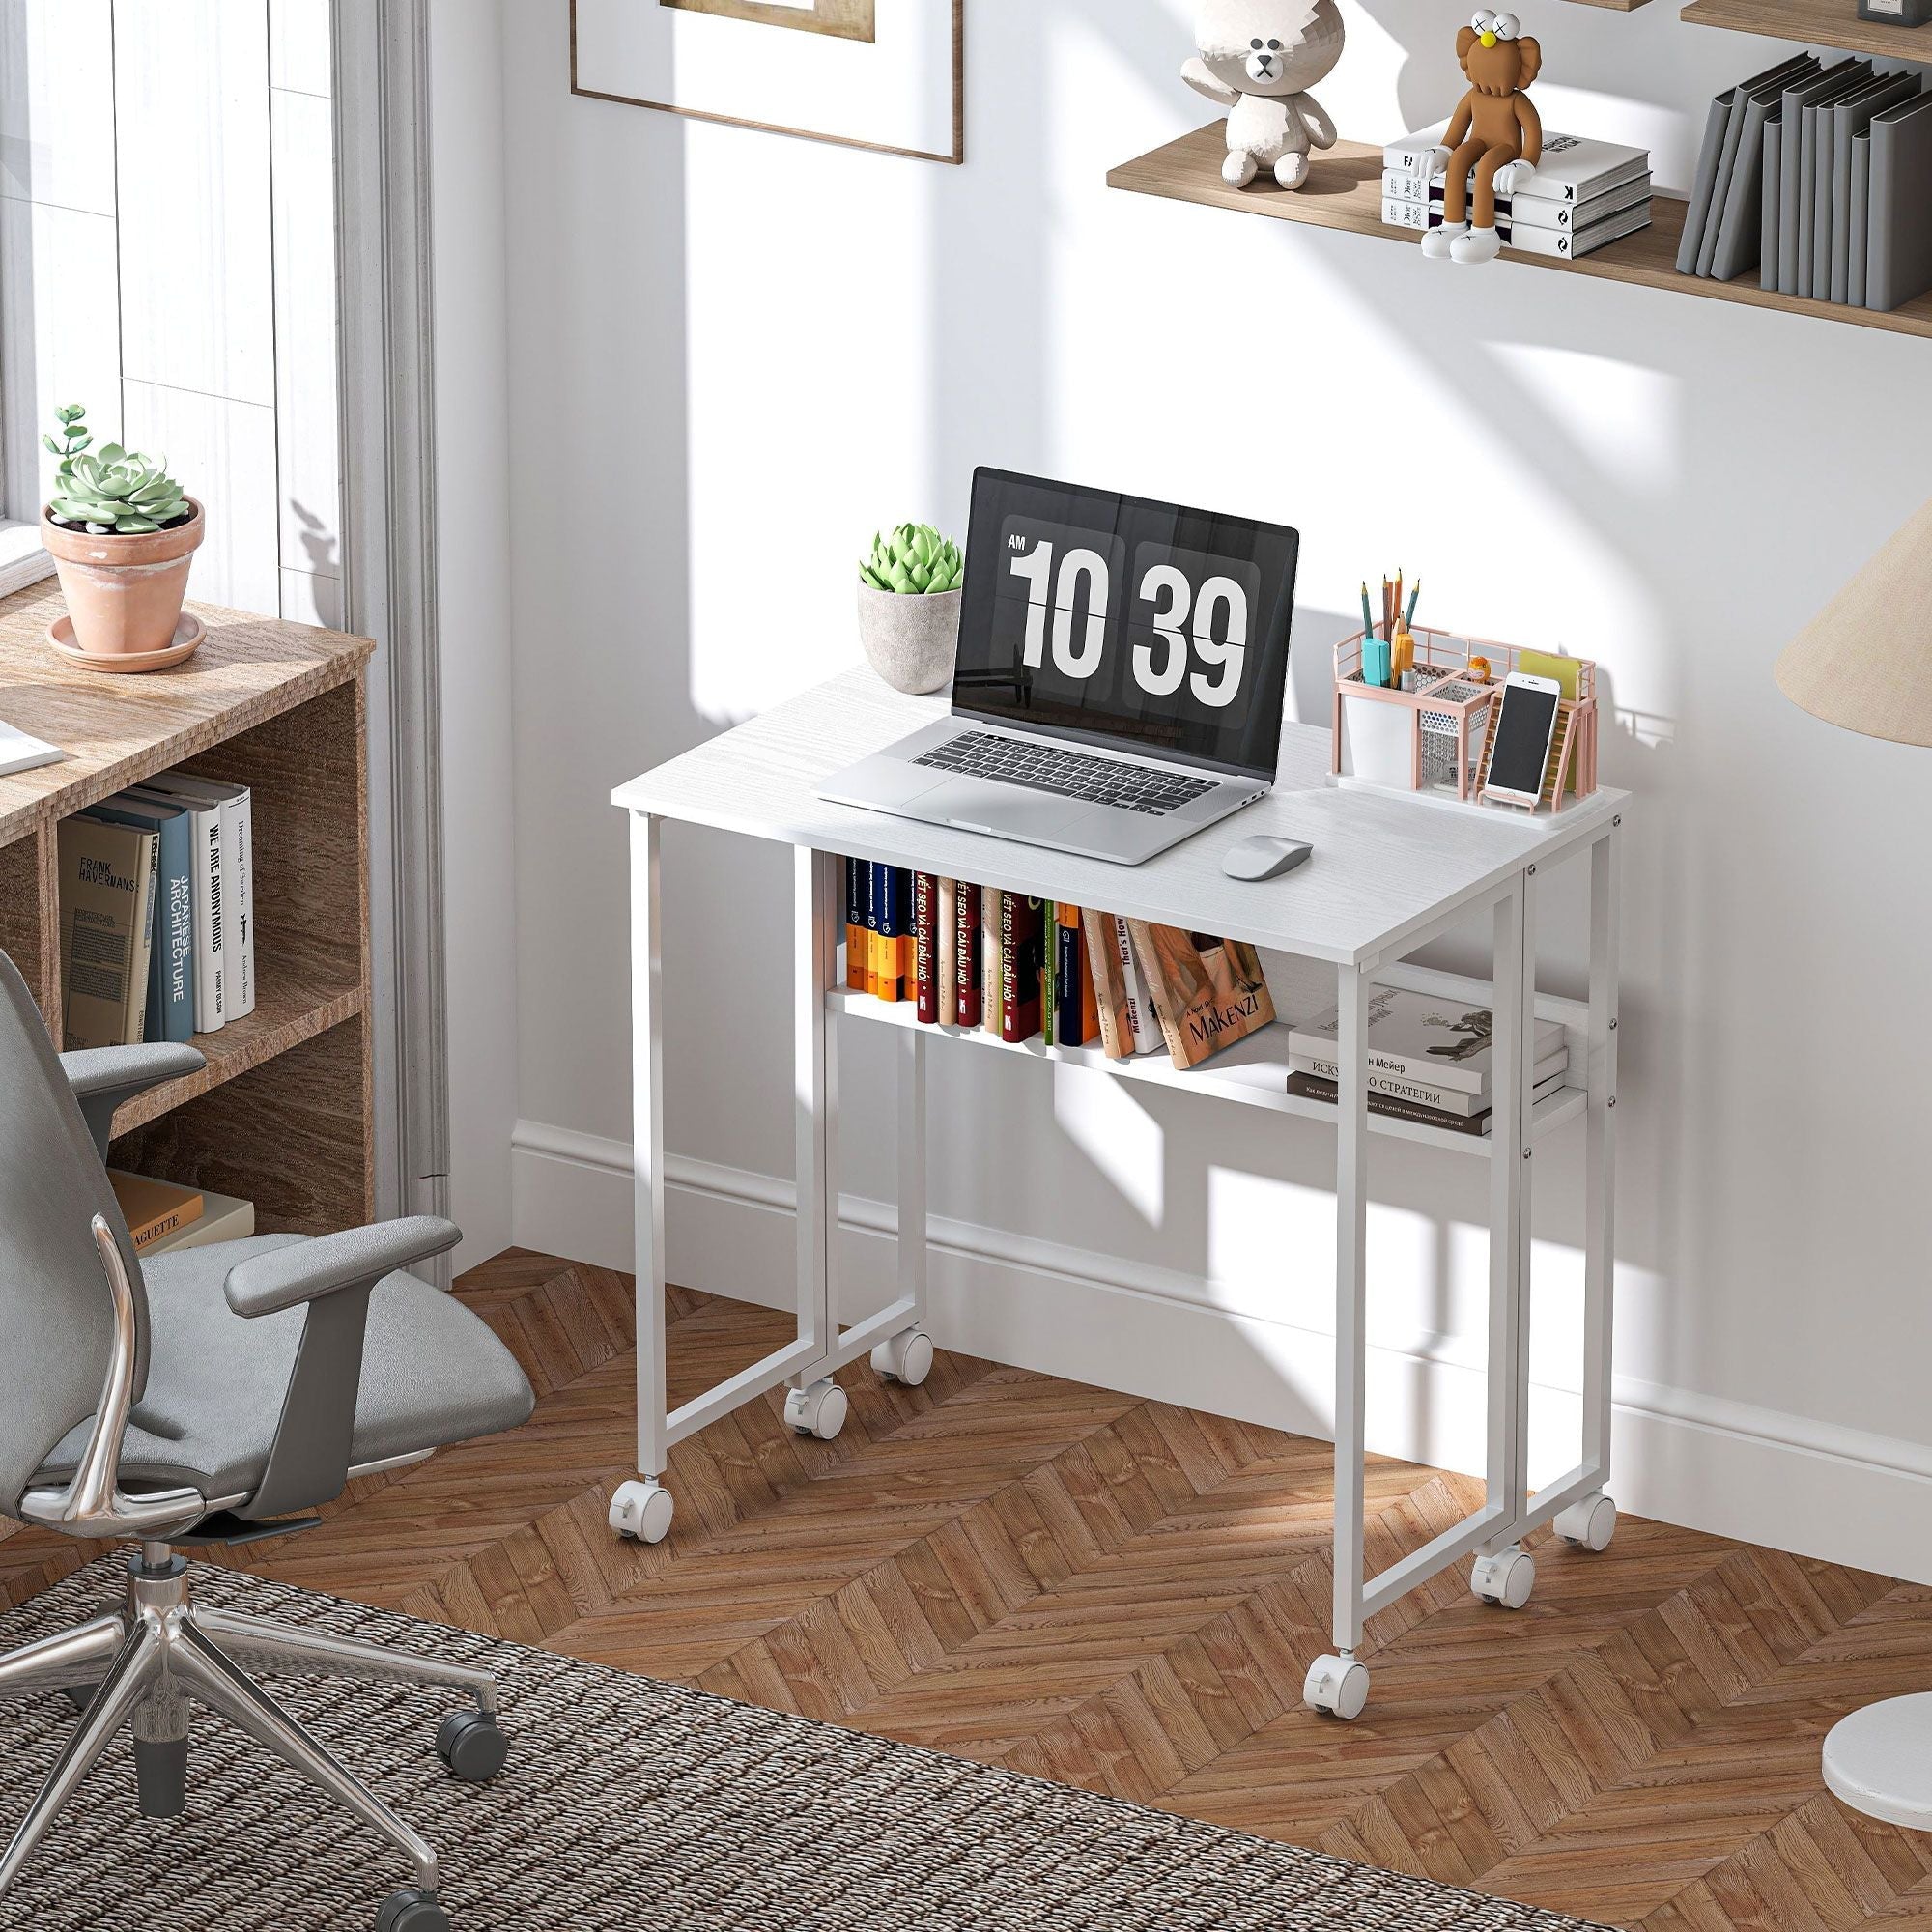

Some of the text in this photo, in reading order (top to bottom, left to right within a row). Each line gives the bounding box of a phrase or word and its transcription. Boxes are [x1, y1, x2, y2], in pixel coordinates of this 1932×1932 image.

[1008, 534, 1026, 551] AM
[1009, 540, 1248, 708] 10 39
[237, 820, 245, 864] Dreaming
[80, 857, 112, 875] FRANK
[209, 823, 222, 953] WE ARE ANONYMOUS
[239, 864, 246, 872] of
[180, 875, 192, 957] JAPANESE
[170, 878, 184, 1003] ARCHITECTURE
[1117, 918, 1131, 966] That's How
[1376, 1057, 1406, 1074] Мейер
[1379, 1079, 1441, 1104] СТРАТЕГИИ
